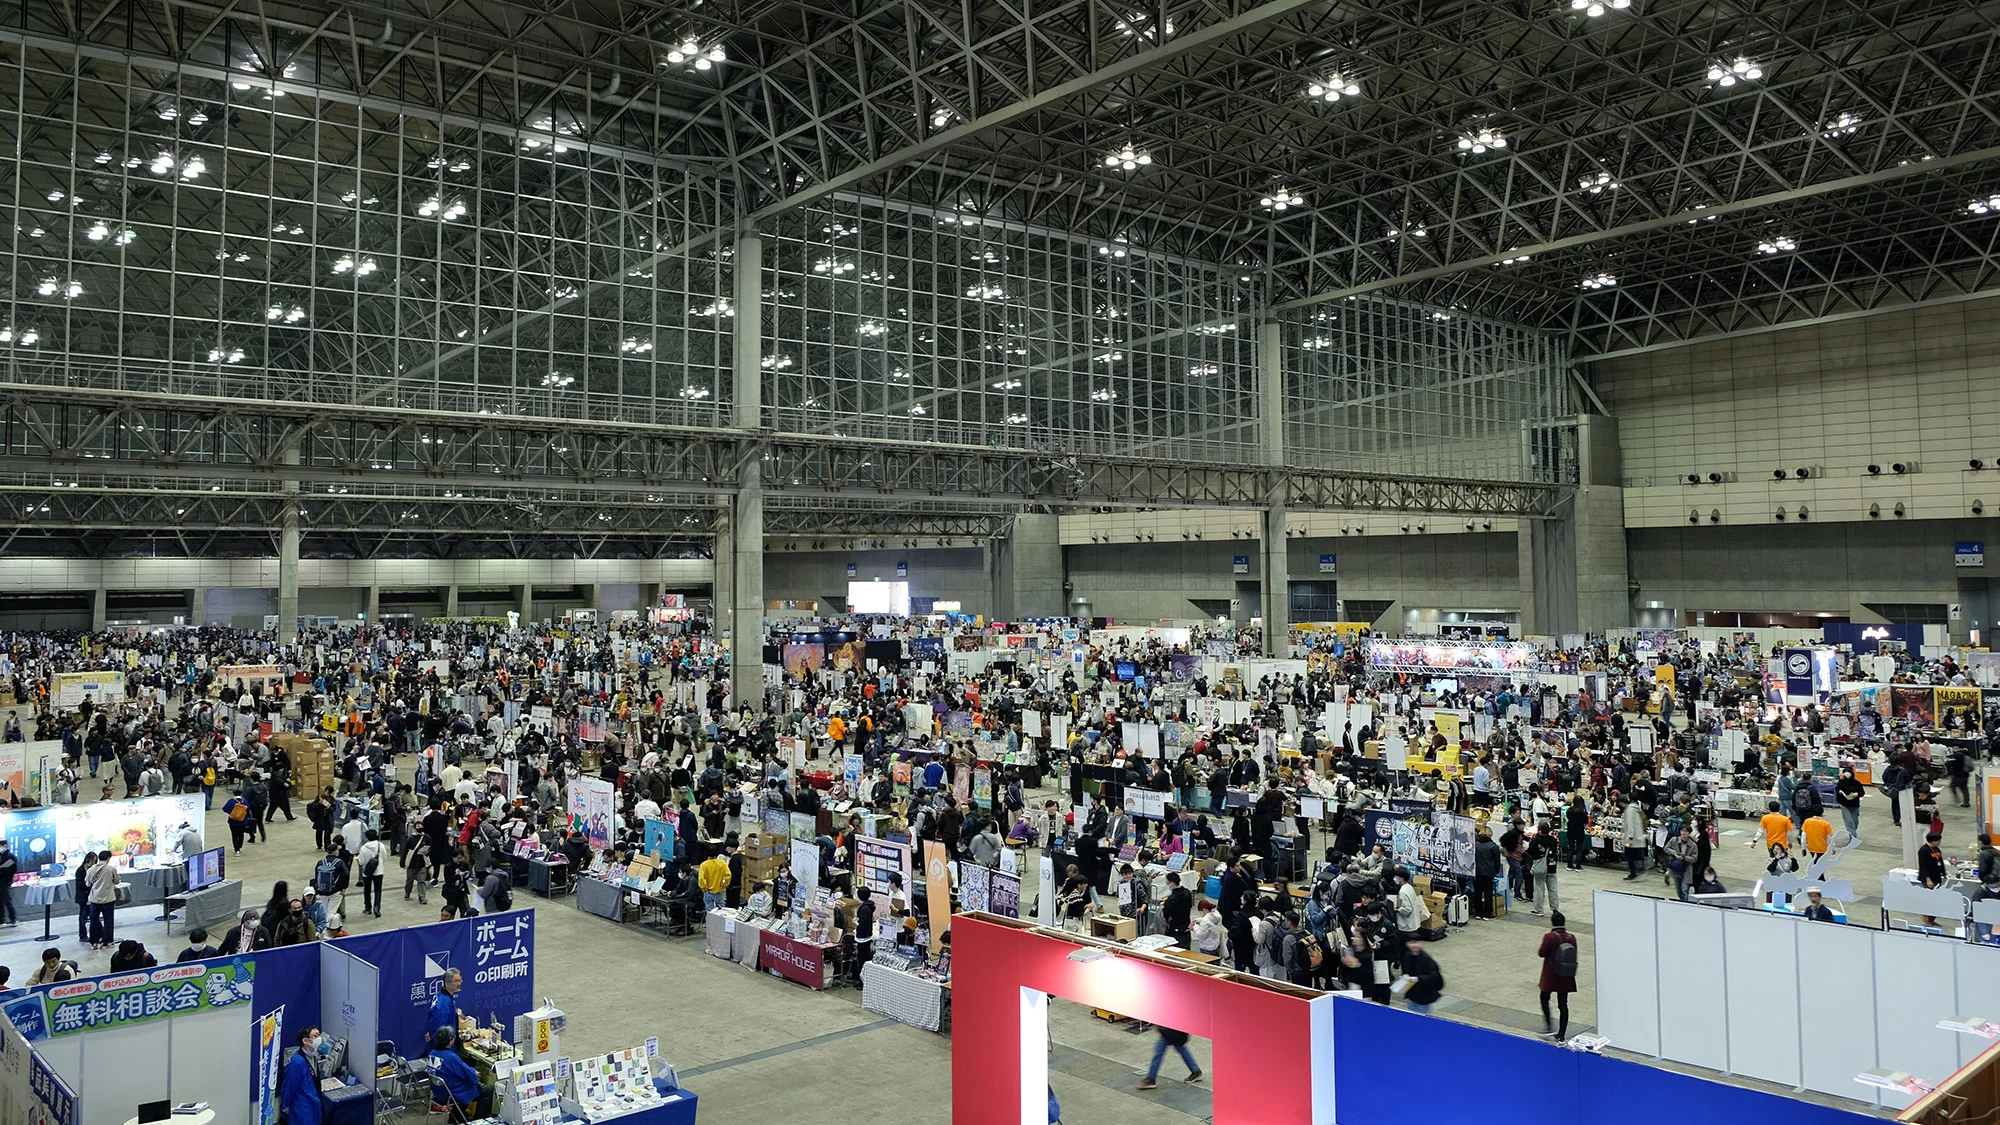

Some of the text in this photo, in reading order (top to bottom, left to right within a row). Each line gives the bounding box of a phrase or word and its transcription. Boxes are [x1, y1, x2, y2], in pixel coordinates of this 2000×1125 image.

[1936, 689, 1979, 700] MAGAZINE
[476, 915, 530, 942] ボード
[476, 939, 529, 966] ゲーム
[765, 944, 816, 974] MIRROR HOUSE
[154, 967, 202, 980] サンプル展示中
[474, 961, 528, 984] の印刷所
[54, 984, 92, 997] 初心者歓迎
[104, 976, 144, 989] 飛び込みOK
[55, 983, 200, 1030] 無料相談会
[474, 992, 529, 1011] FACTORY
[12, 1010, 40, 1024] ゲーム
